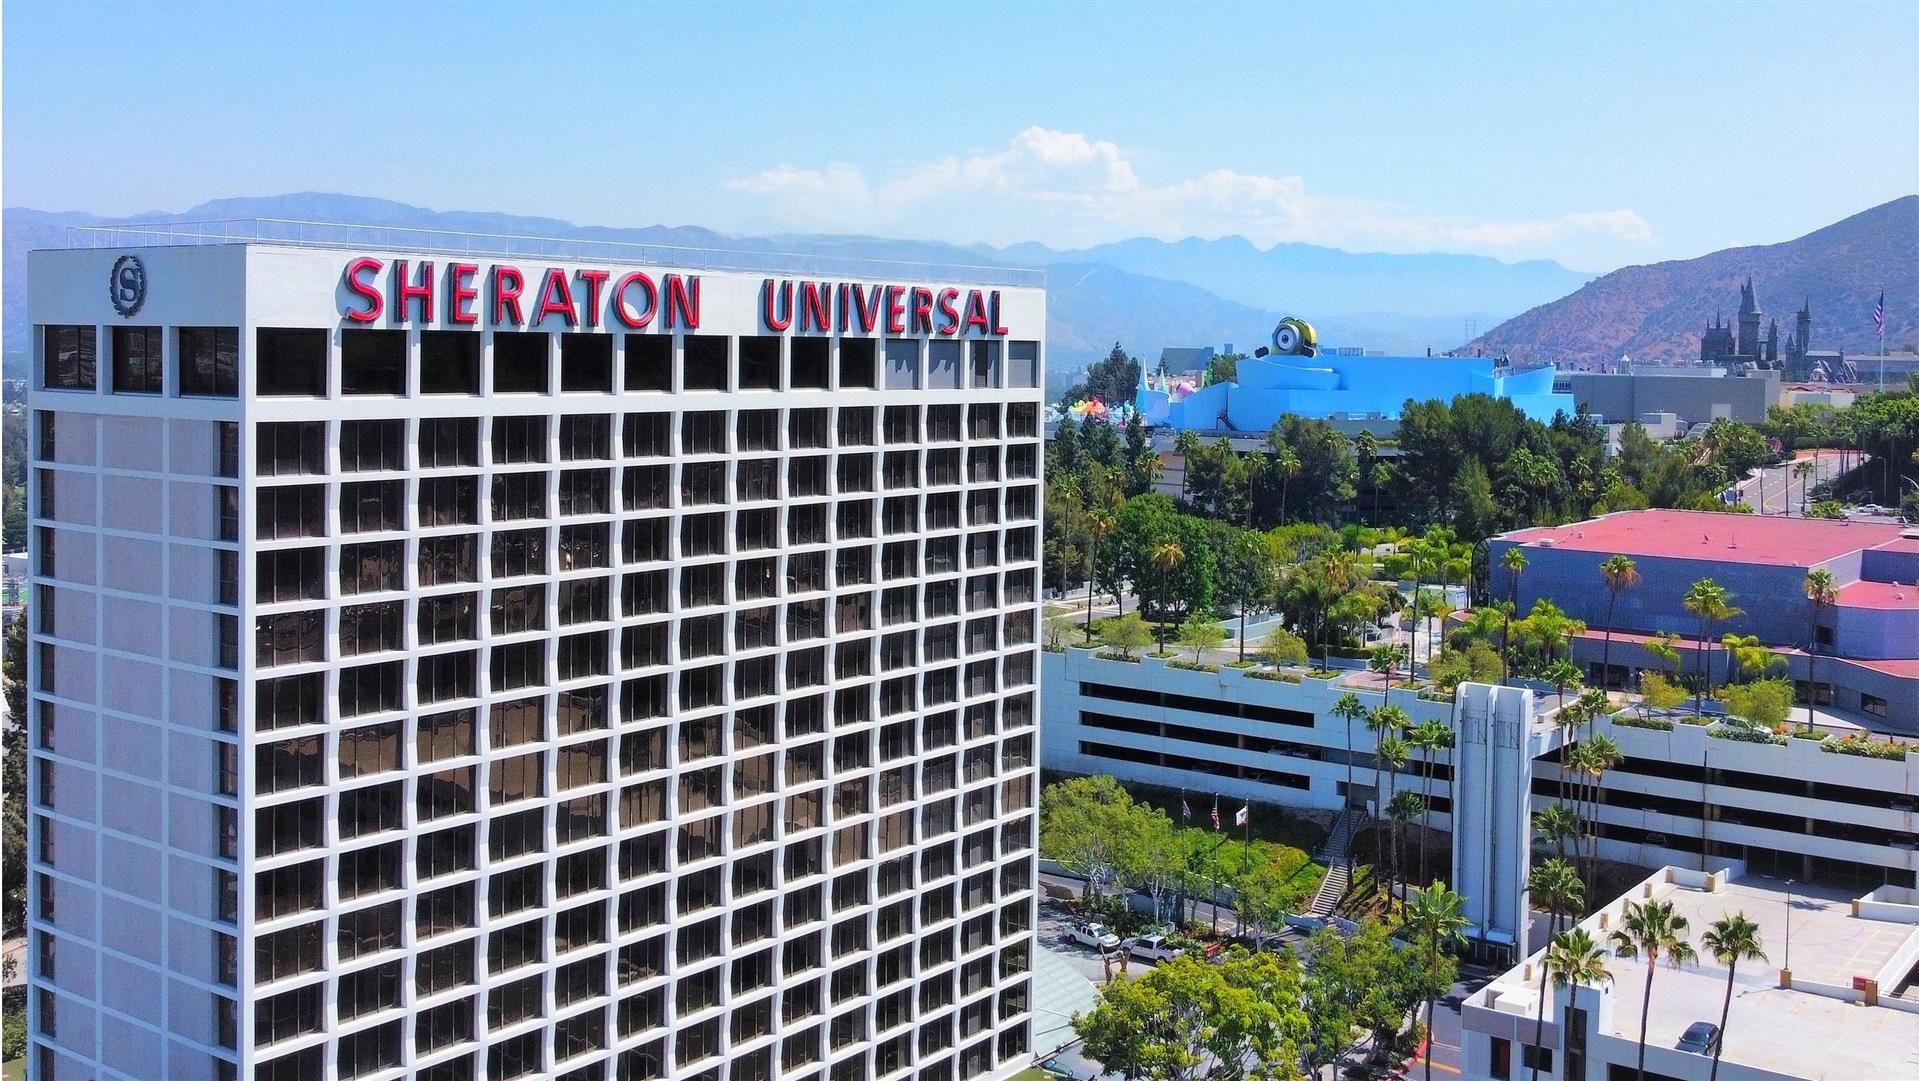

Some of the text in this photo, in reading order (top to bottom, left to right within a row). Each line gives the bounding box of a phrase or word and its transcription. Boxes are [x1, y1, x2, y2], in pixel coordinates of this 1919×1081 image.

[120, 267, 139, 301] S
[345, 257, 1008, 335] SHERATON UNIVERSAL
